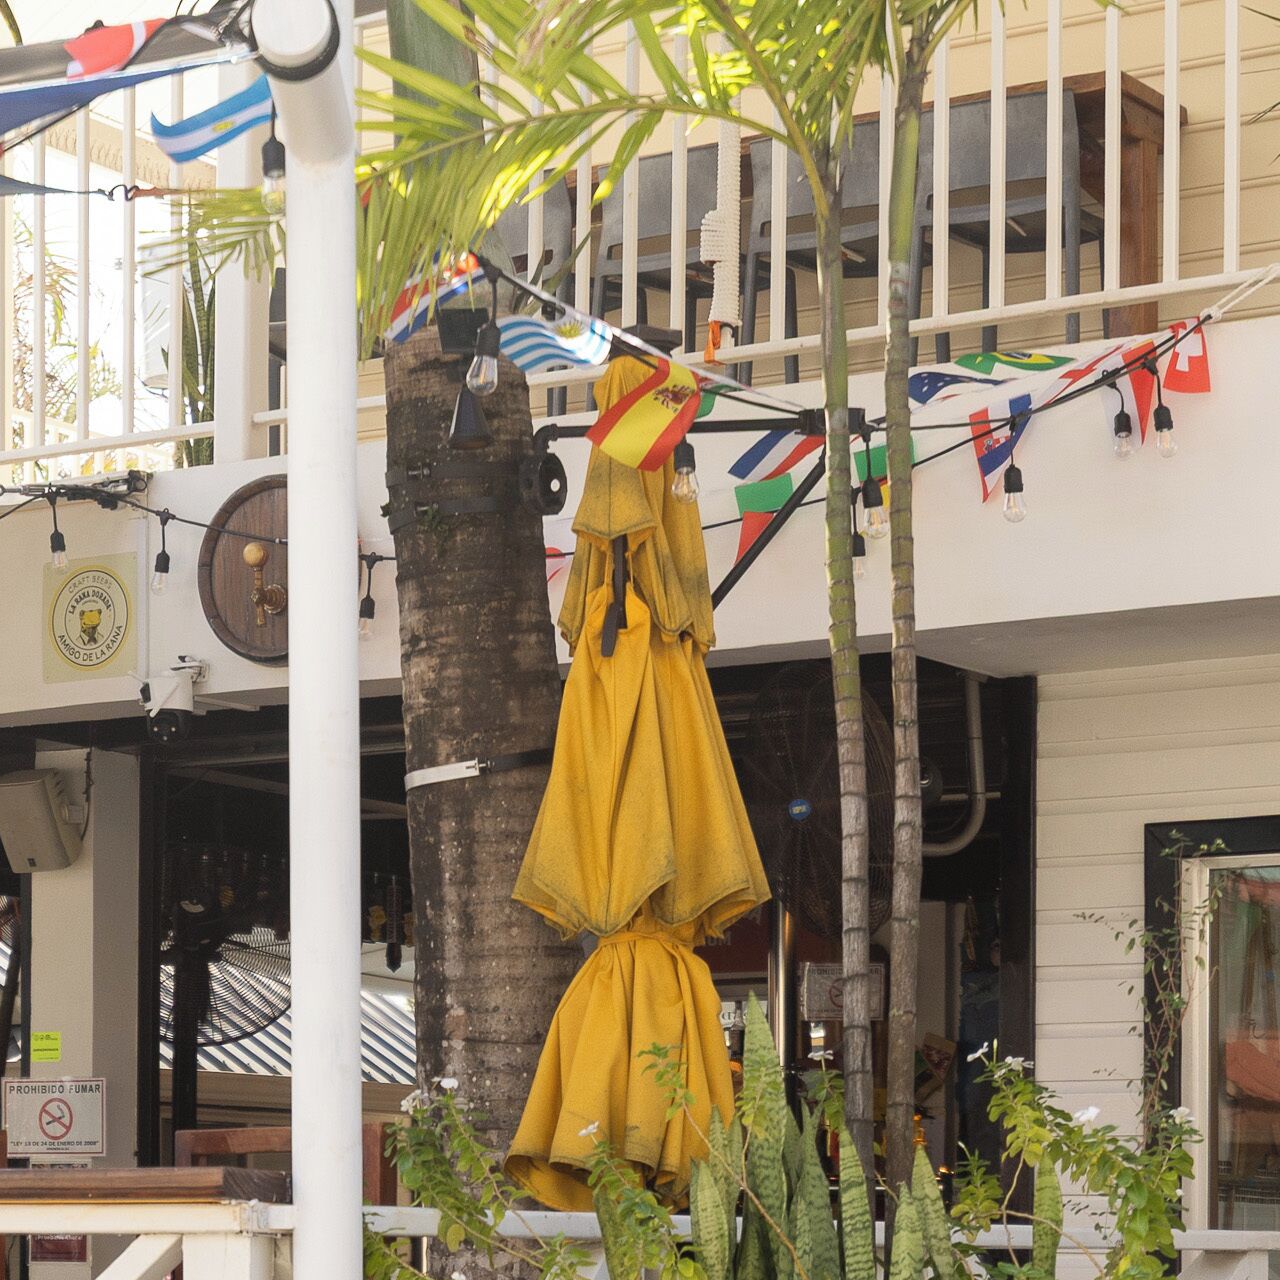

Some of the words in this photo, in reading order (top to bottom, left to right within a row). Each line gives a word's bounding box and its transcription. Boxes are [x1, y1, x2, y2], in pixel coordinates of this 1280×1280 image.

[68, 575, 90, 594] CRAFT
[75, 590, 90, 605] RANA
[58, 634, 81, 660] AMIGO
[82, 652, 94, 662] DE
[95, 649, 106, 660] LA
[106, 625, 123, 652] RANA
[9, 1085, 64, 1094] PROHIBIDO
[68, 1084, 100, 1094] FUMAR
